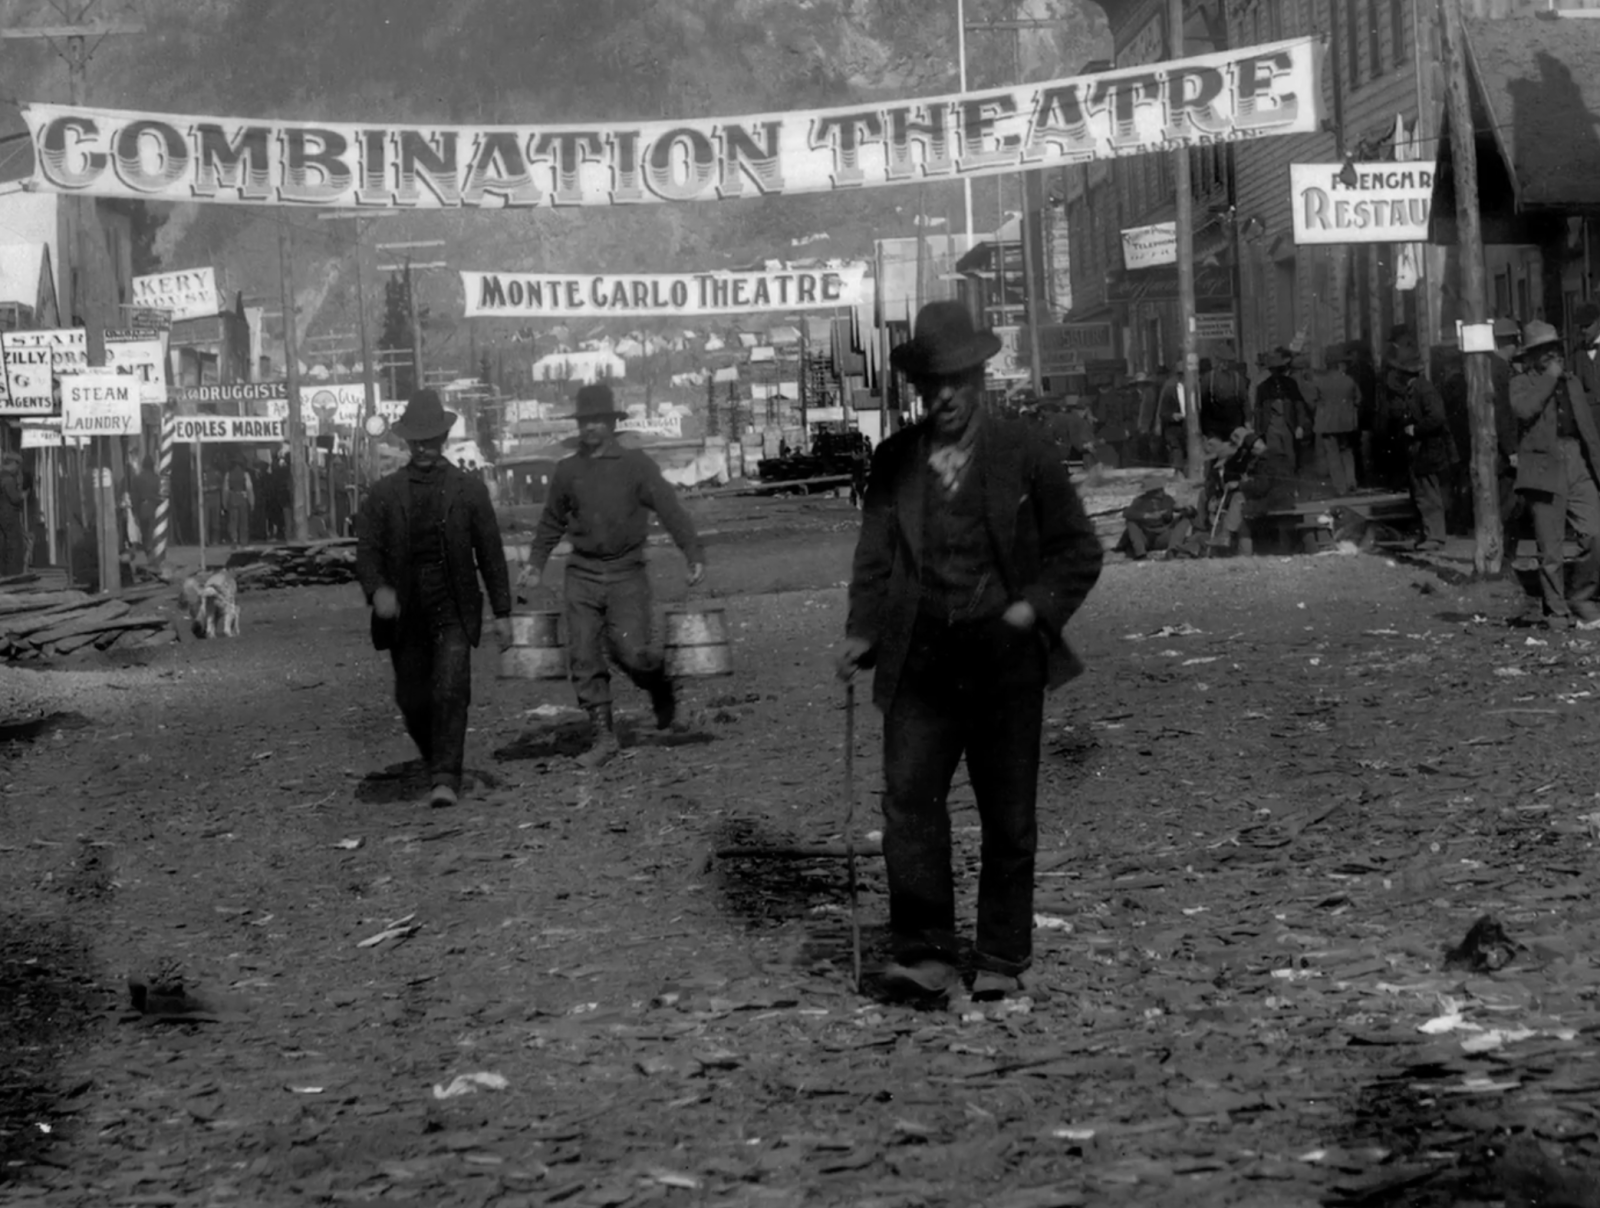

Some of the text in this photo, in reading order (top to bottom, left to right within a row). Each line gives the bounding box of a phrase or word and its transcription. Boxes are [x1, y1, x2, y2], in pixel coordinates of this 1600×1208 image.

[38, 51, 1299, 208] COMBINATION THEATRE
[480, 273, 842, 309] MONTE CARLO THEATRE
[71, 387, 128, 401] STEAM
[200, 383, 287, 400] DRUGGISTS
[65, 411, 131, 434] LAUNDRY
[175, 419, 287, 438] EOPLES MARKET
